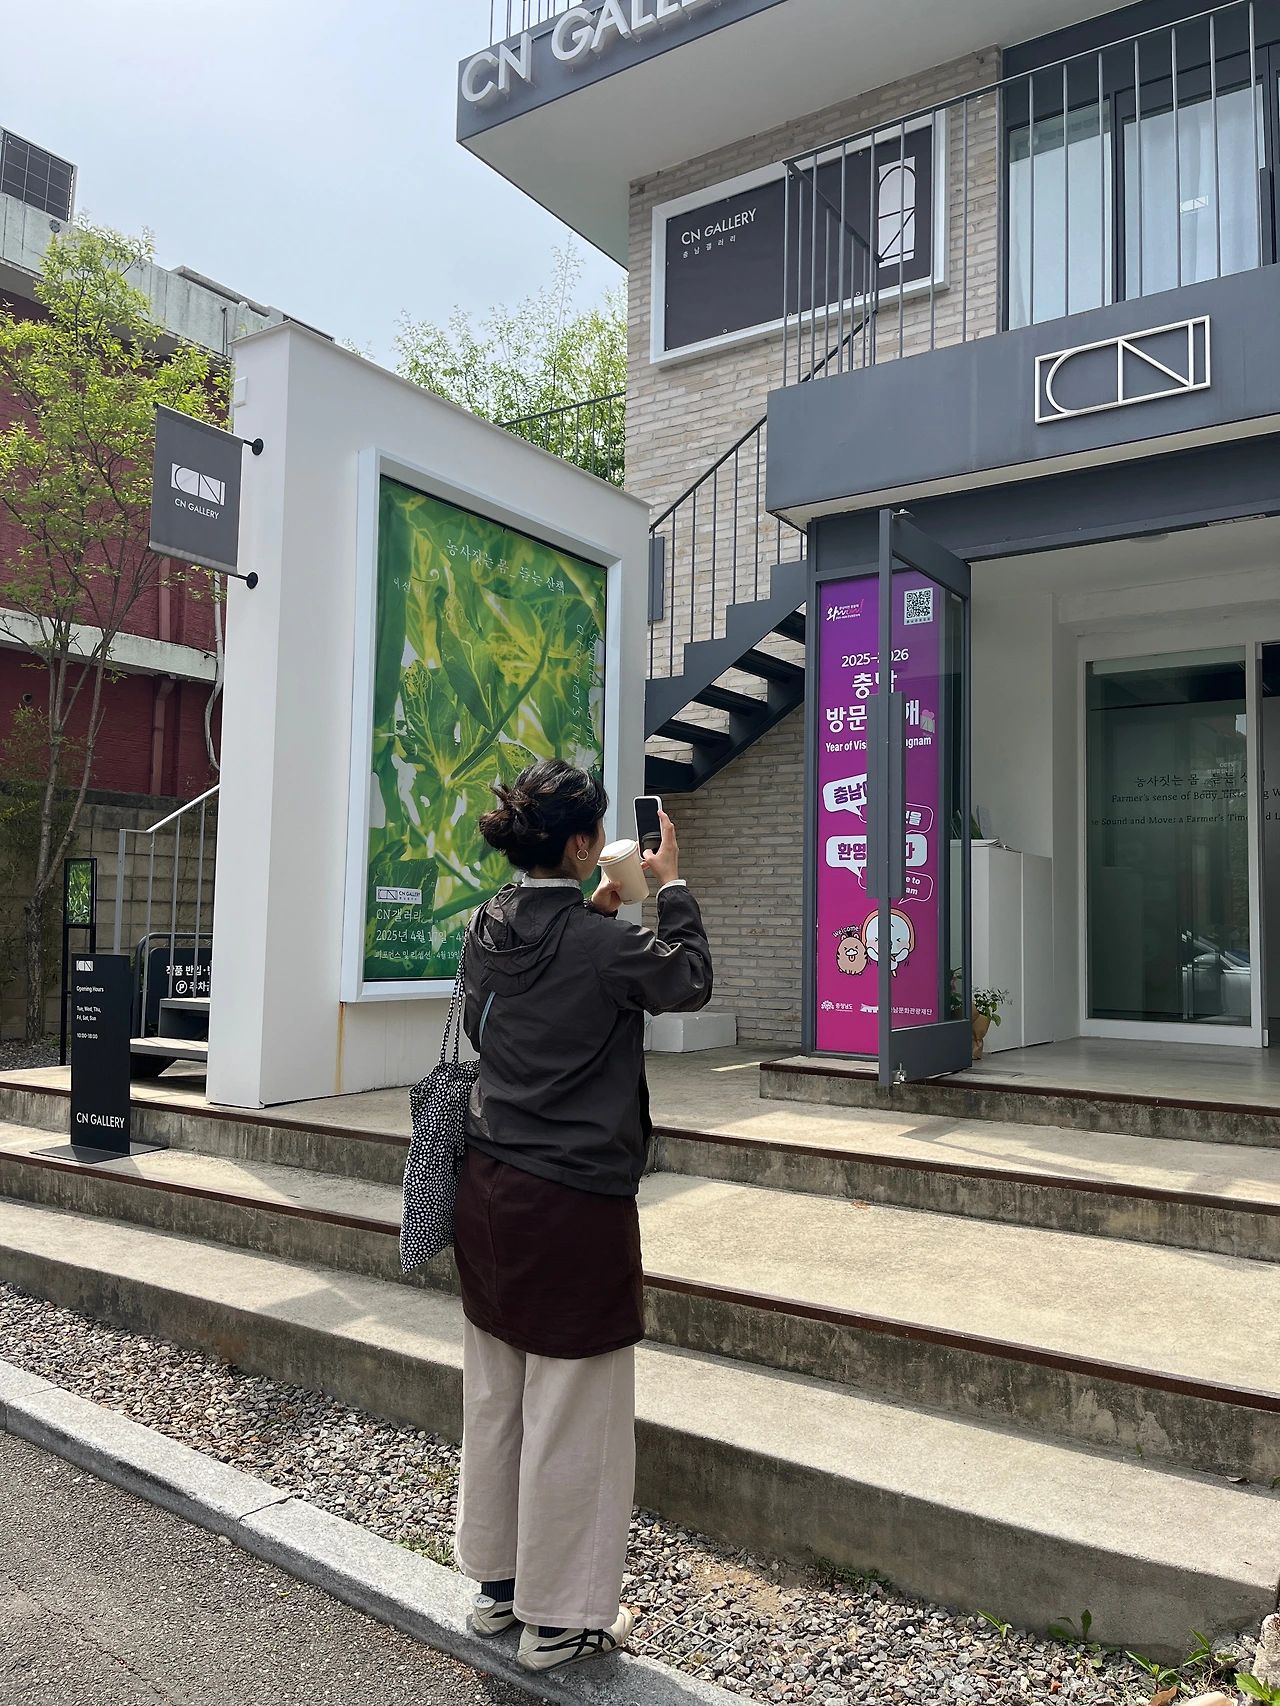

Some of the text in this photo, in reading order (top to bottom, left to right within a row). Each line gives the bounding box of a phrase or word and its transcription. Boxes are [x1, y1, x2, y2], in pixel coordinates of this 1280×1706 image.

[461, 32, 534, 102] CN
[681, 208, 757, 245] CN GALLERY
[174, 498, 220, 520] CN GALLERY
[446, 539, 494, 570] 농사짓는
[545, 576, 566, 596] 산책
[825, 742, 843, 753] Year
[844, 740, 853, 751] of
[1135, 774, 1183, 788] 농사짓는
[1112, 794, 1150, 803] Farmer's
[1152, 794, 1178, 802] sense
[1180, 791, 1192, 800] of
[1102, 817, 1127, 826] Sound
[1131, 816, 1146, 825] and
[1149, 816, 1176, 824] Move:
[1187, 813, 1224, 823] Farmer's
[911, 876, 921, 885] to
[376, 929, 408, 943] 2025년
[411, 930, 426, 943] 4월
[403, 949, 409, 960] 및
[76, 985, 92, 994] Opening
[890, 1006, 933, 1016] 남문화관광재단
[76, 1111, 125, 1129] CN GALLERY
